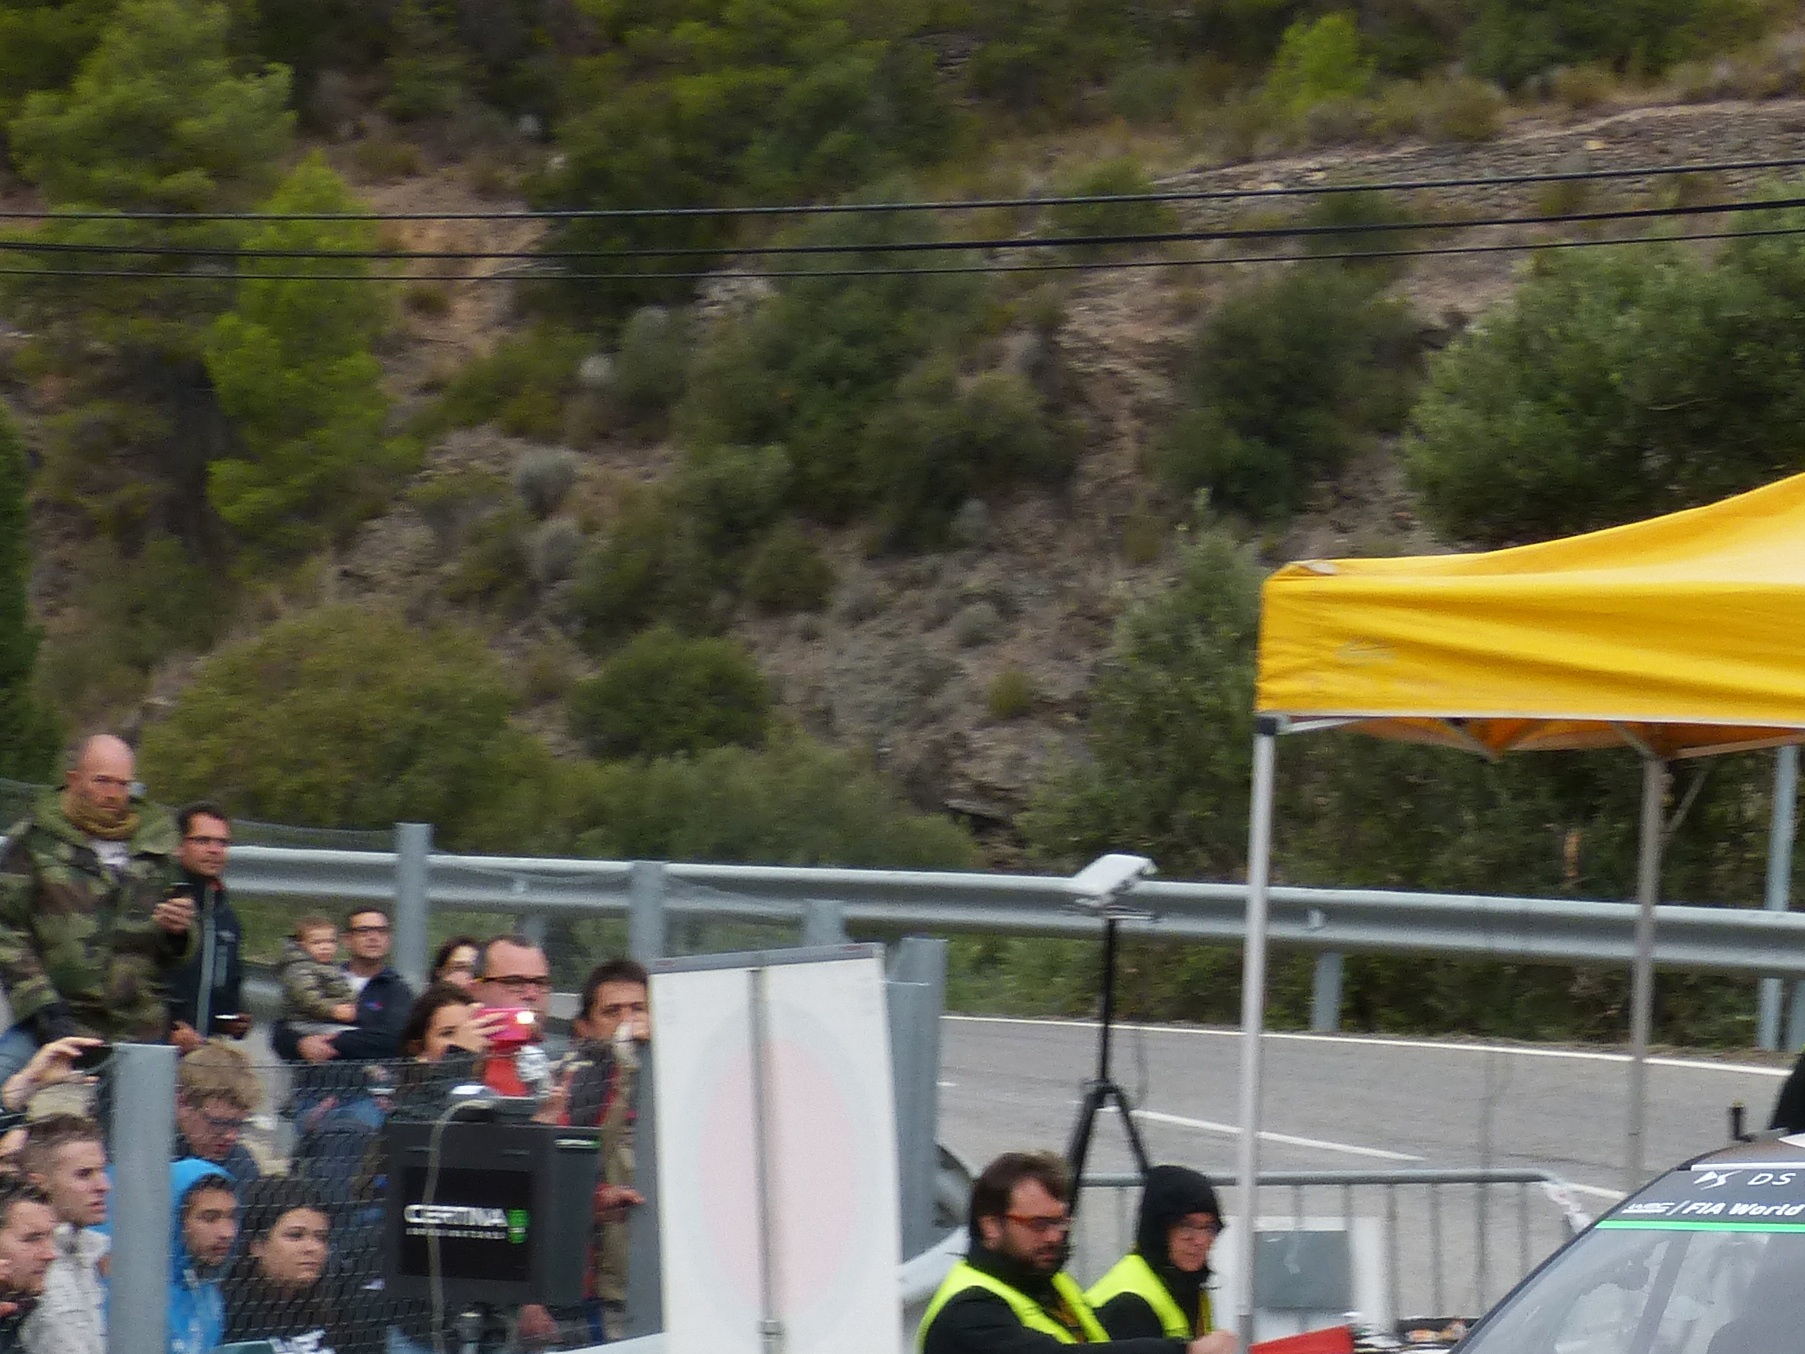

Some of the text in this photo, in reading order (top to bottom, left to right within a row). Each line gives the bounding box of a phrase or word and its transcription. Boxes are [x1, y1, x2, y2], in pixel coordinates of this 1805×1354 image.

[1747, 1173, 1796, 1187] DS
[1688, 1201, 1726, 1215] FIA
[1728, 1203, 1802, 1217] World
